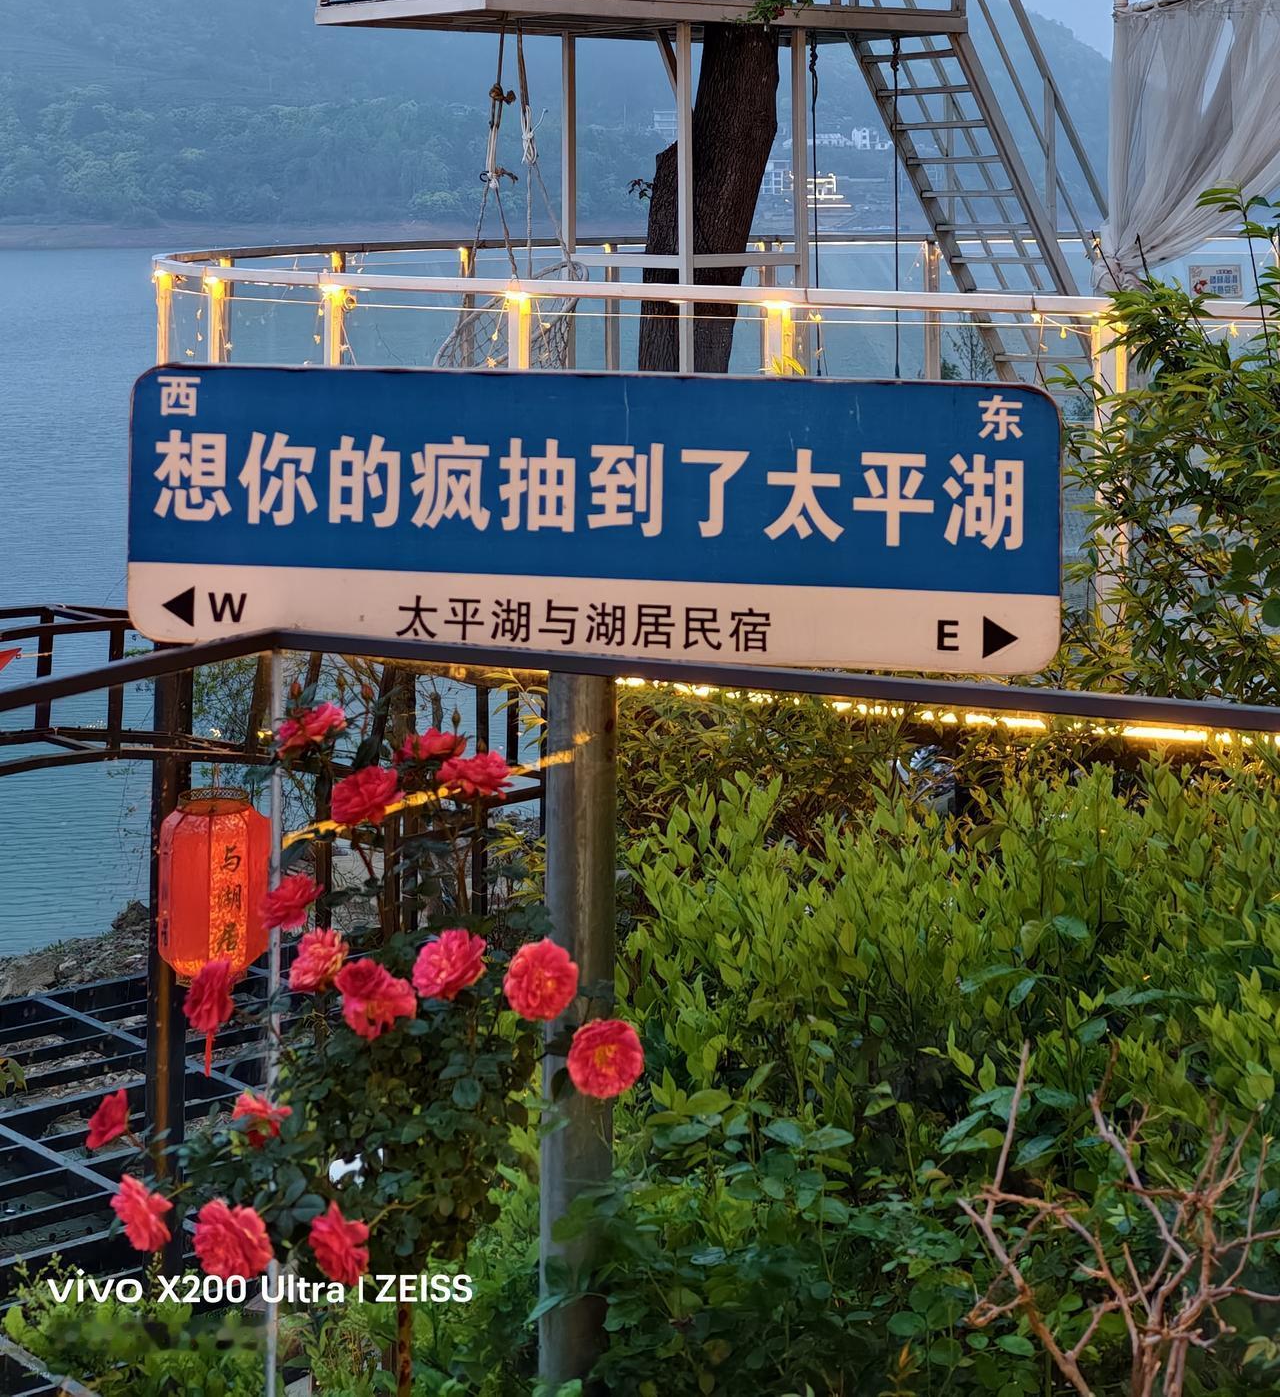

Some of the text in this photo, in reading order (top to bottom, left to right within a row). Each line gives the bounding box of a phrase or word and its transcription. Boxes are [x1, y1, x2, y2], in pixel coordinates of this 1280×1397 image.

[157, 376, 201, 417] 西
[978, 395, 1023, 441] 东
[154, 429, 1024, 550] 想你的疯抽到了太平湖
[208, 593, 247, 623] W
[395, 595, 772, 652] 太平湖与湖居民宿
[936, 620, 960, 652] E
[215, 845, 242, 953] 与湖居
